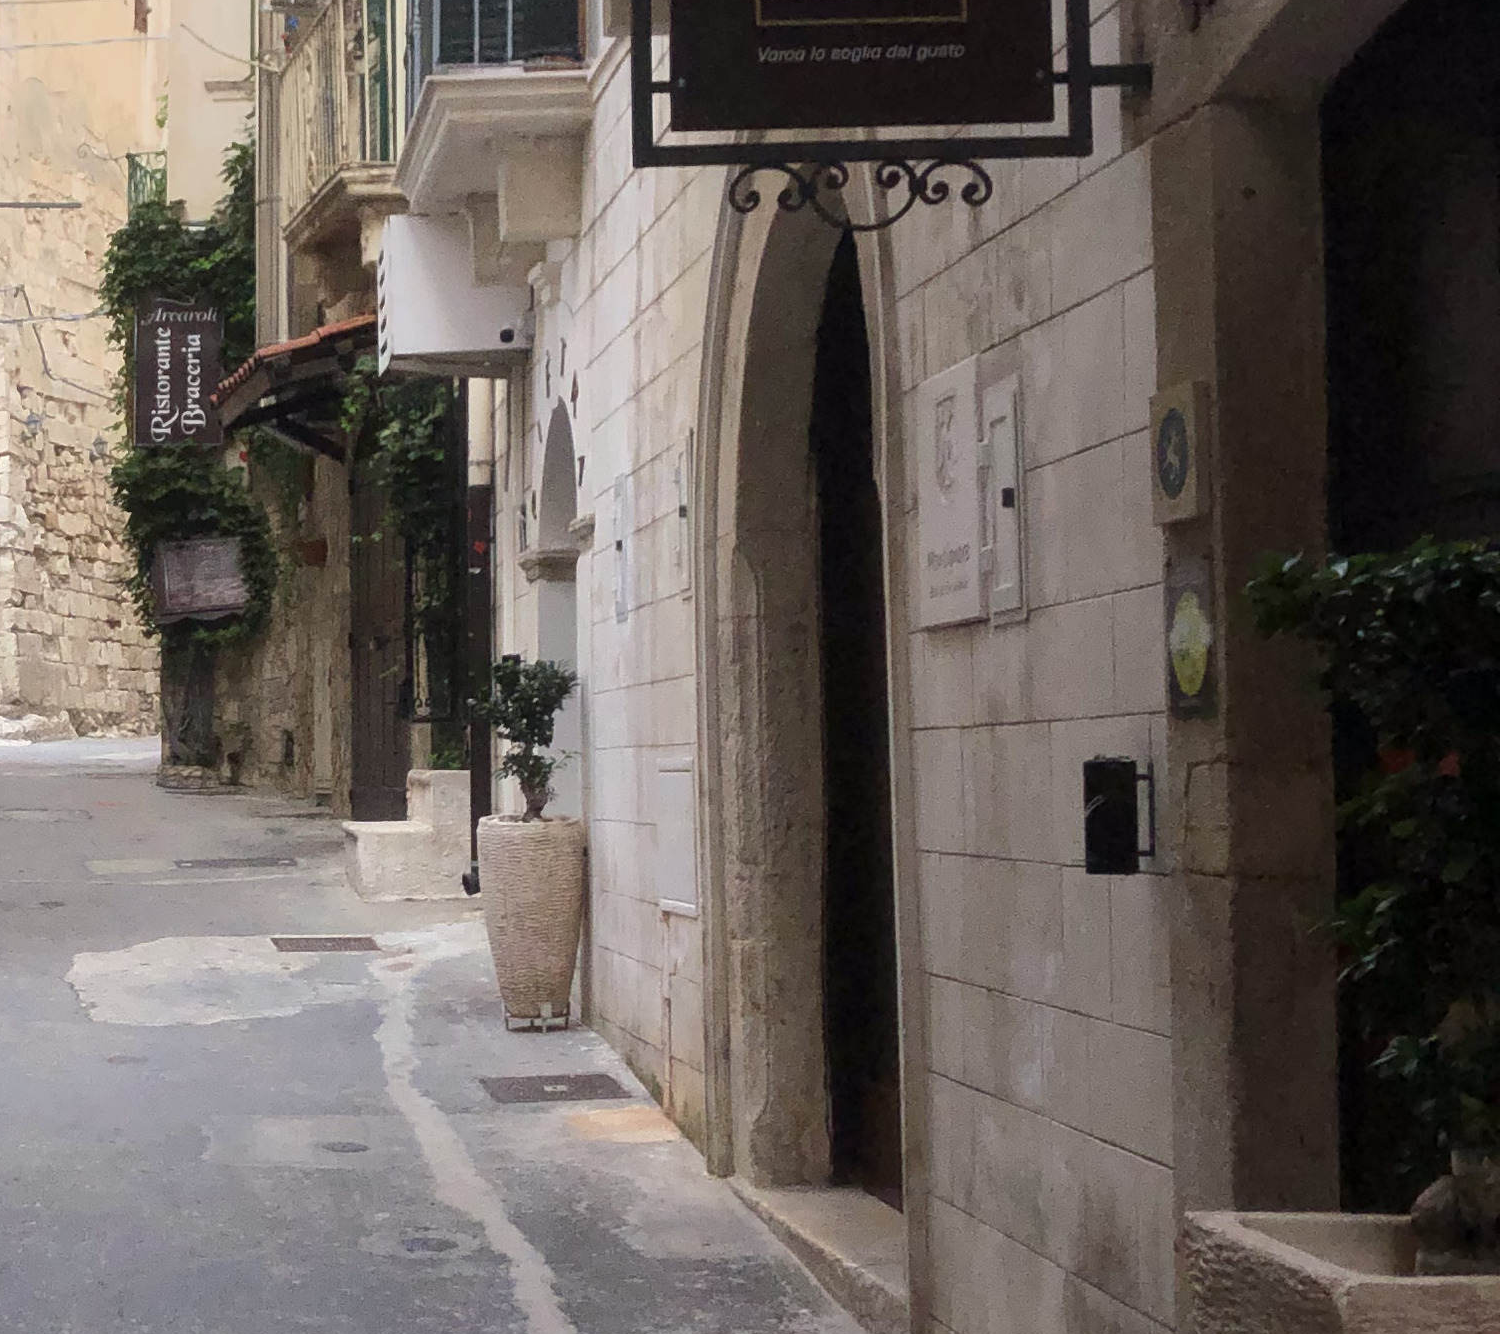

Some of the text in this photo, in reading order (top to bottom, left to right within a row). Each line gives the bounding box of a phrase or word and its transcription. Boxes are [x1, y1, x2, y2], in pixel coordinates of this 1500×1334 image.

[916, 43, 965, 62] gusto
[141, 306, 218, 325] Arcaroli
[151, 326, 180, 443] Ristorante
[180, 333, 207, 436] Braceria
